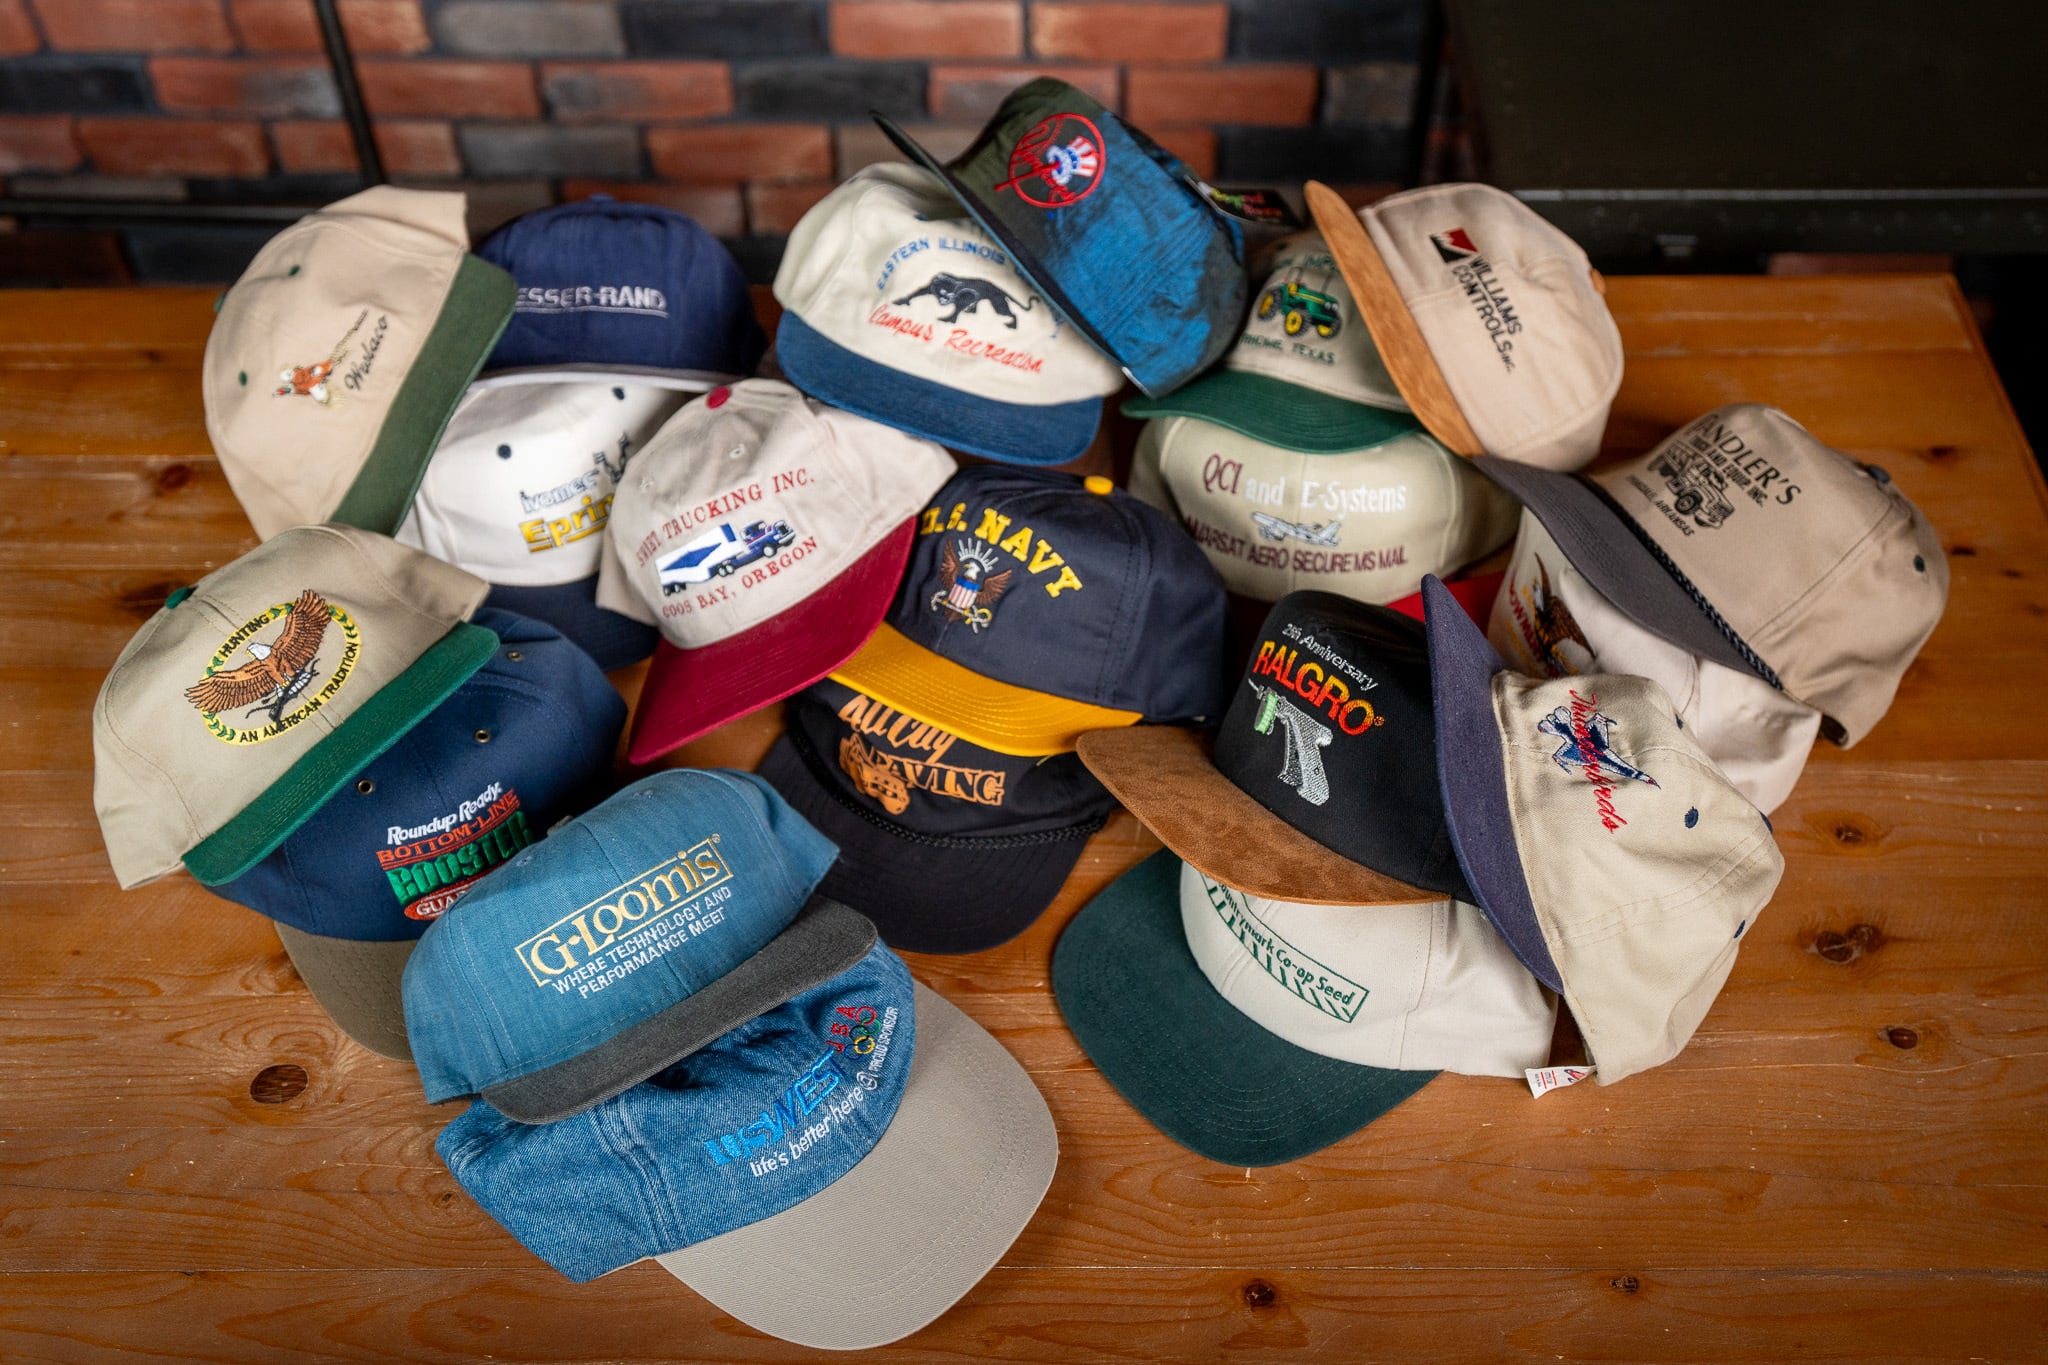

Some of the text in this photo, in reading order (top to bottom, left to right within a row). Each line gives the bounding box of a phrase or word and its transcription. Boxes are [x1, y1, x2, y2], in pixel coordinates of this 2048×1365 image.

[877, 237, 1006, 290] EASTERN ILLINOIS
[1468, 256, 1523, 336] WILLIAMS
[868, 303, 934, 342] Campus
[1451, 264, 1513, 354] CONTROLS
[662, 483, 763, 540] TRUCKING
[771, 468, 815, 494] INC.
[1245, 475, 1286, 506] and
[1300, 480, 1407, 519] E-Systems
[662, 536, 817, 619] COOS BAY, OREGON
[974, 507, 1083, 598] NAVY
[218, 613, 271, 658] HUNTING
[1300, 634, 1379, 692] Anniversary
[239, 642, 359, 743] AN AMERICAN TRADITION
[1252, 640, 1375, 736] RALGRO
[375, 788, 518, 864] BOTTOM-LINE
[387, 813, 457, 846] Roundup
[552, 886, 732, 995] WHERE TECHNOLOGY AND
[577, 906, 726, 999] PERFORMANCE MEET
[1218, 883, 1356, 1006] ountrymark Co-op Seed
[879, 1006, 899, 1046] SPONSOR
[749, 1086, 864, 1178] life's better here
